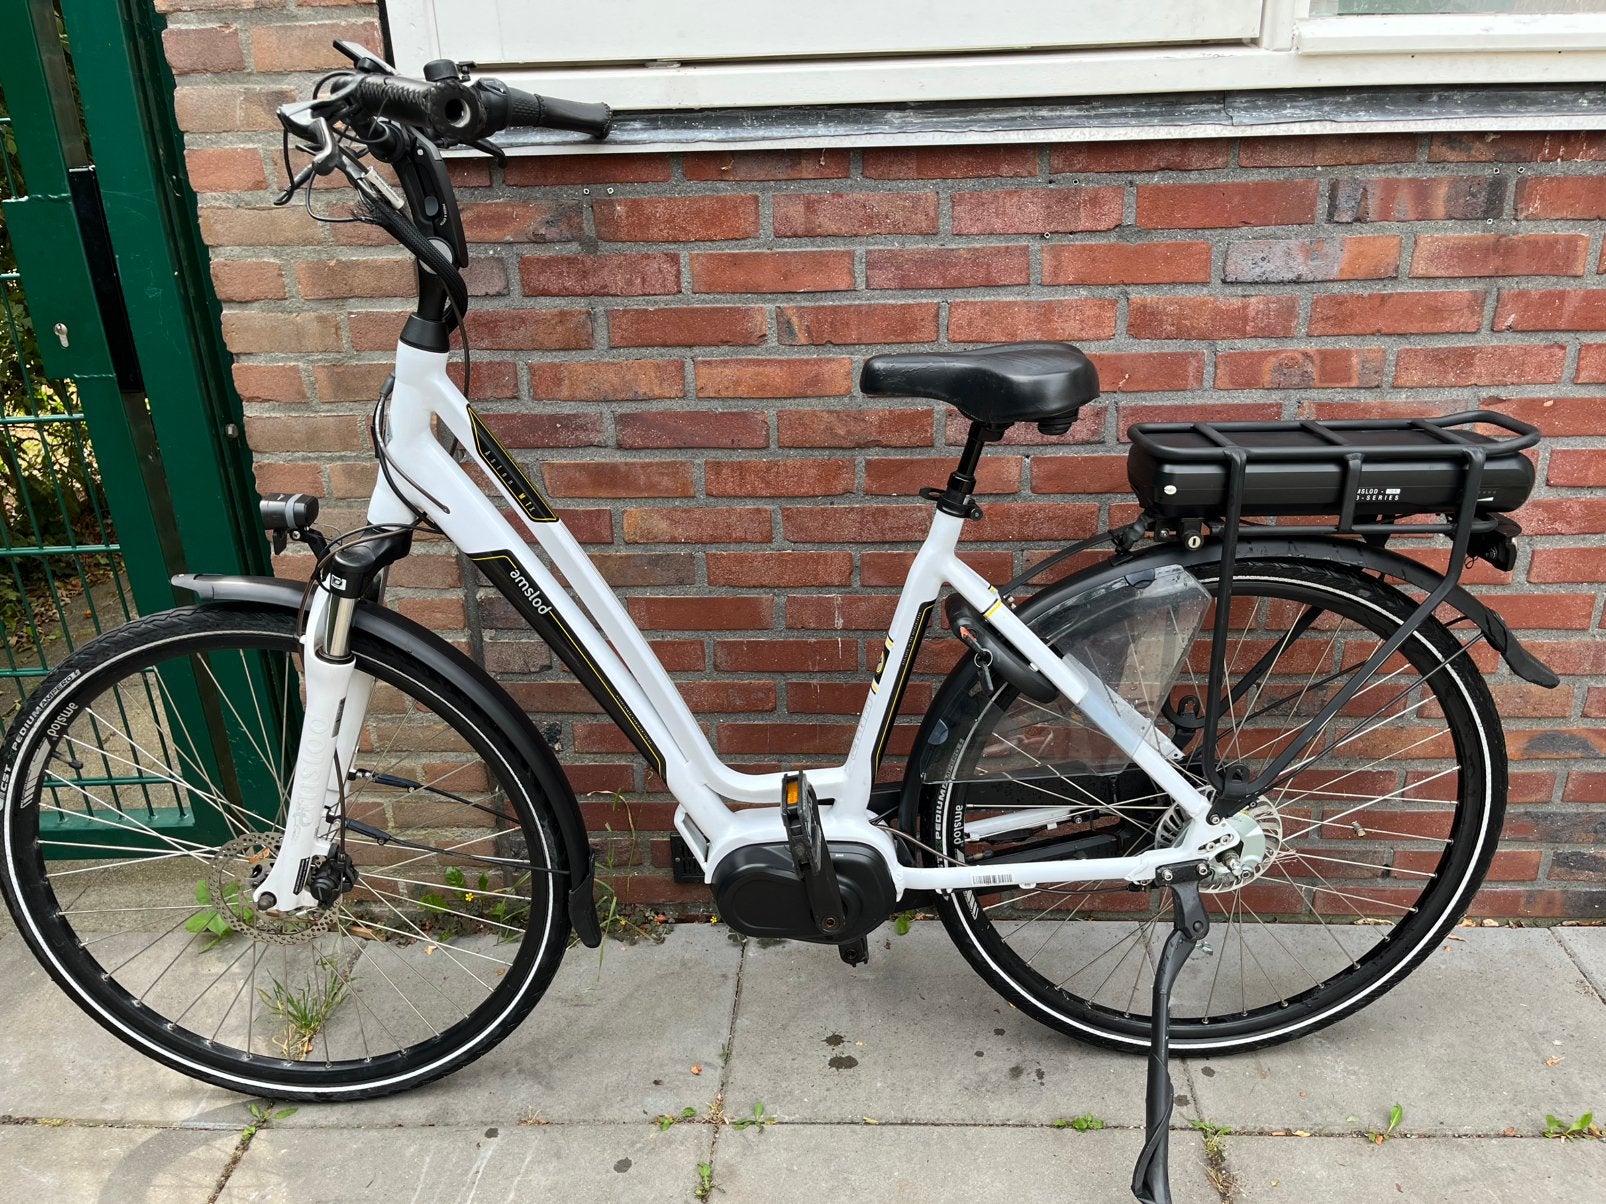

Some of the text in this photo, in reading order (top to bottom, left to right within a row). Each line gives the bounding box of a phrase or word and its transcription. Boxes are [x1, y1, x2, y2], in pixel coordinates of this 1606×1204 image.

[509, 569, 552, 614] amslod
[46, 702, 79, 738] amslod
[0, 763, 12, 792] CST
[953, 804, 964, 846] amslod
